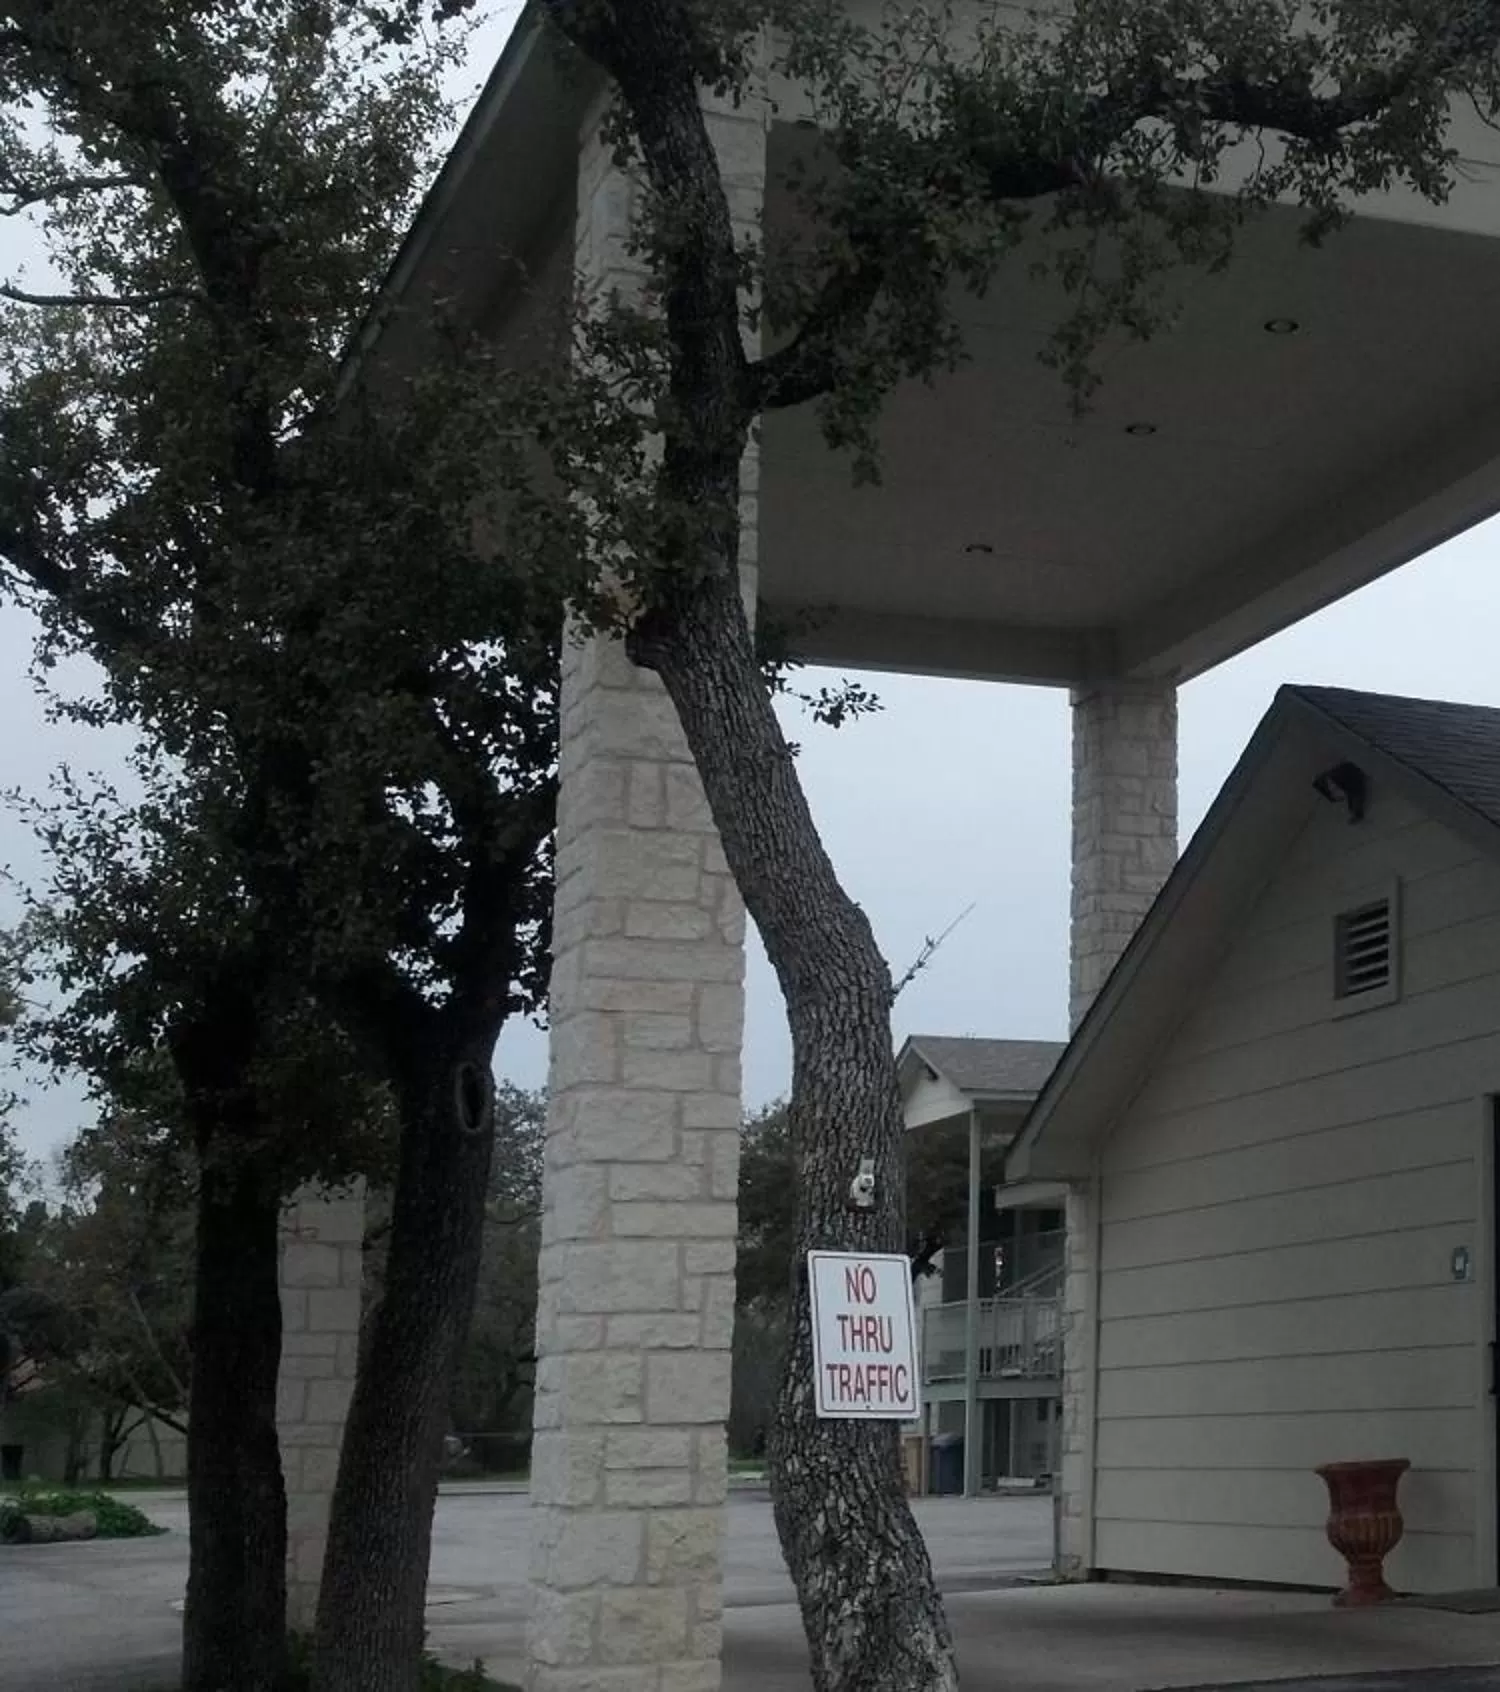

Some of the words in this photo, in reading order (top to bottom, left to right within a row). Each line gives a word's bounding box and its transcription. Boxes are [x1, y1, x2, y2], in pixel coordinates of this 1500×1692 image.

[845, 1266, 876, 1304] NO
[836, 1314, 893, 1353] THRU
[826, 1364, 909, 1403] TRAFFIC
